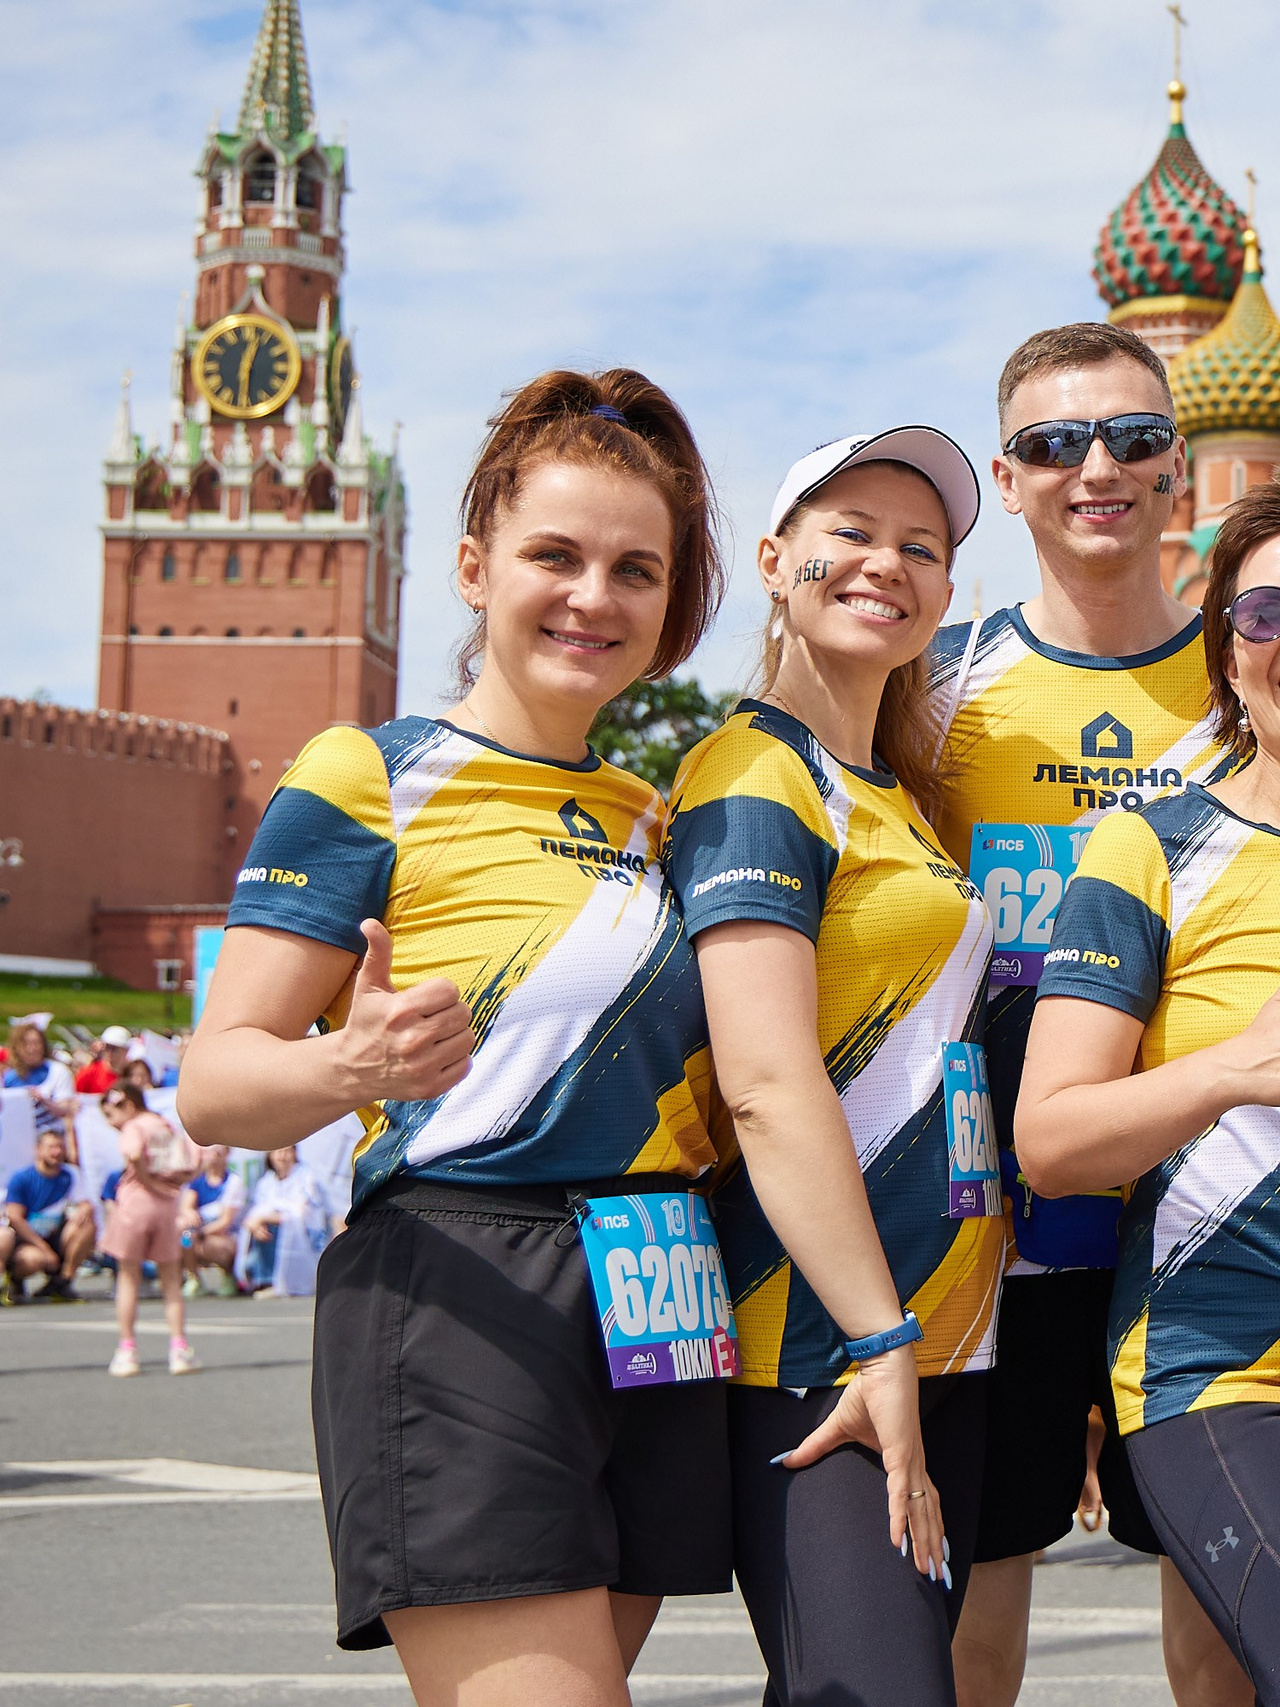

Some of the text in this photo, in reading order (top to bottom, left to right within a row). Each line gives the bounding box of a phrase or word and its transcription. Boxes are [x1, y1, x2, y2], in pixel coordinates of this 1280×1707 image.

[1033, 763, 1182, 787] ЛЕМАНА
[1073, 788, 1144, 812] ПРО
[539, 837, 649, 876] ЛЕМАНА
[996, 839, 1025, 852] ПСБ
[237, 867, 308, 887] АНА ПРО
[576, 862, 634, 887] ПРО
[692, 867, 802, 898] ЛЕМАНА ПРО
[983, 867, 1075, 944] 62
[1081, 950, 1120, 969] ПРО
[604, 1214, 630, 1230] ПСБ
[661, 1198, 685, 1237] 10
[605, 1243, 730, 1337] 62073
